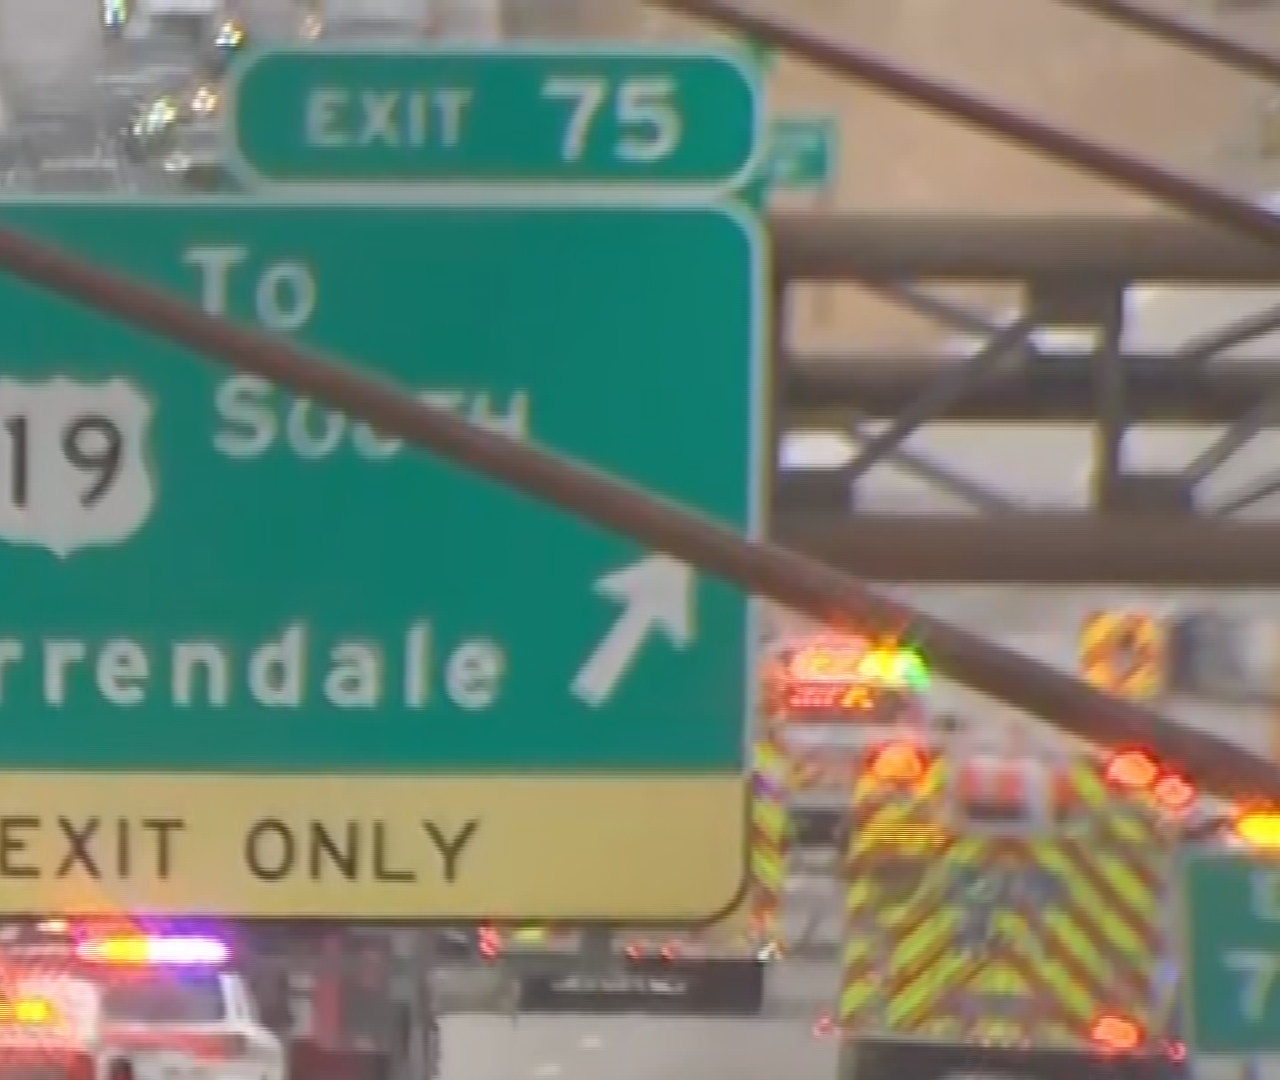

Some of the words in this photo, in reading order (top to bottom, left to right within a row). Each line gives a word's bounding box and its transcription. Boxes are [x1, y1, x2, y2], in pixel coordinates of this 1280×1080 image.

[304, 90, 472, 147] EXIT
[542, 80, 680, 162] 75
[0, 416, 124, 508] 19
[245, 819, 480, 884] ONLY
